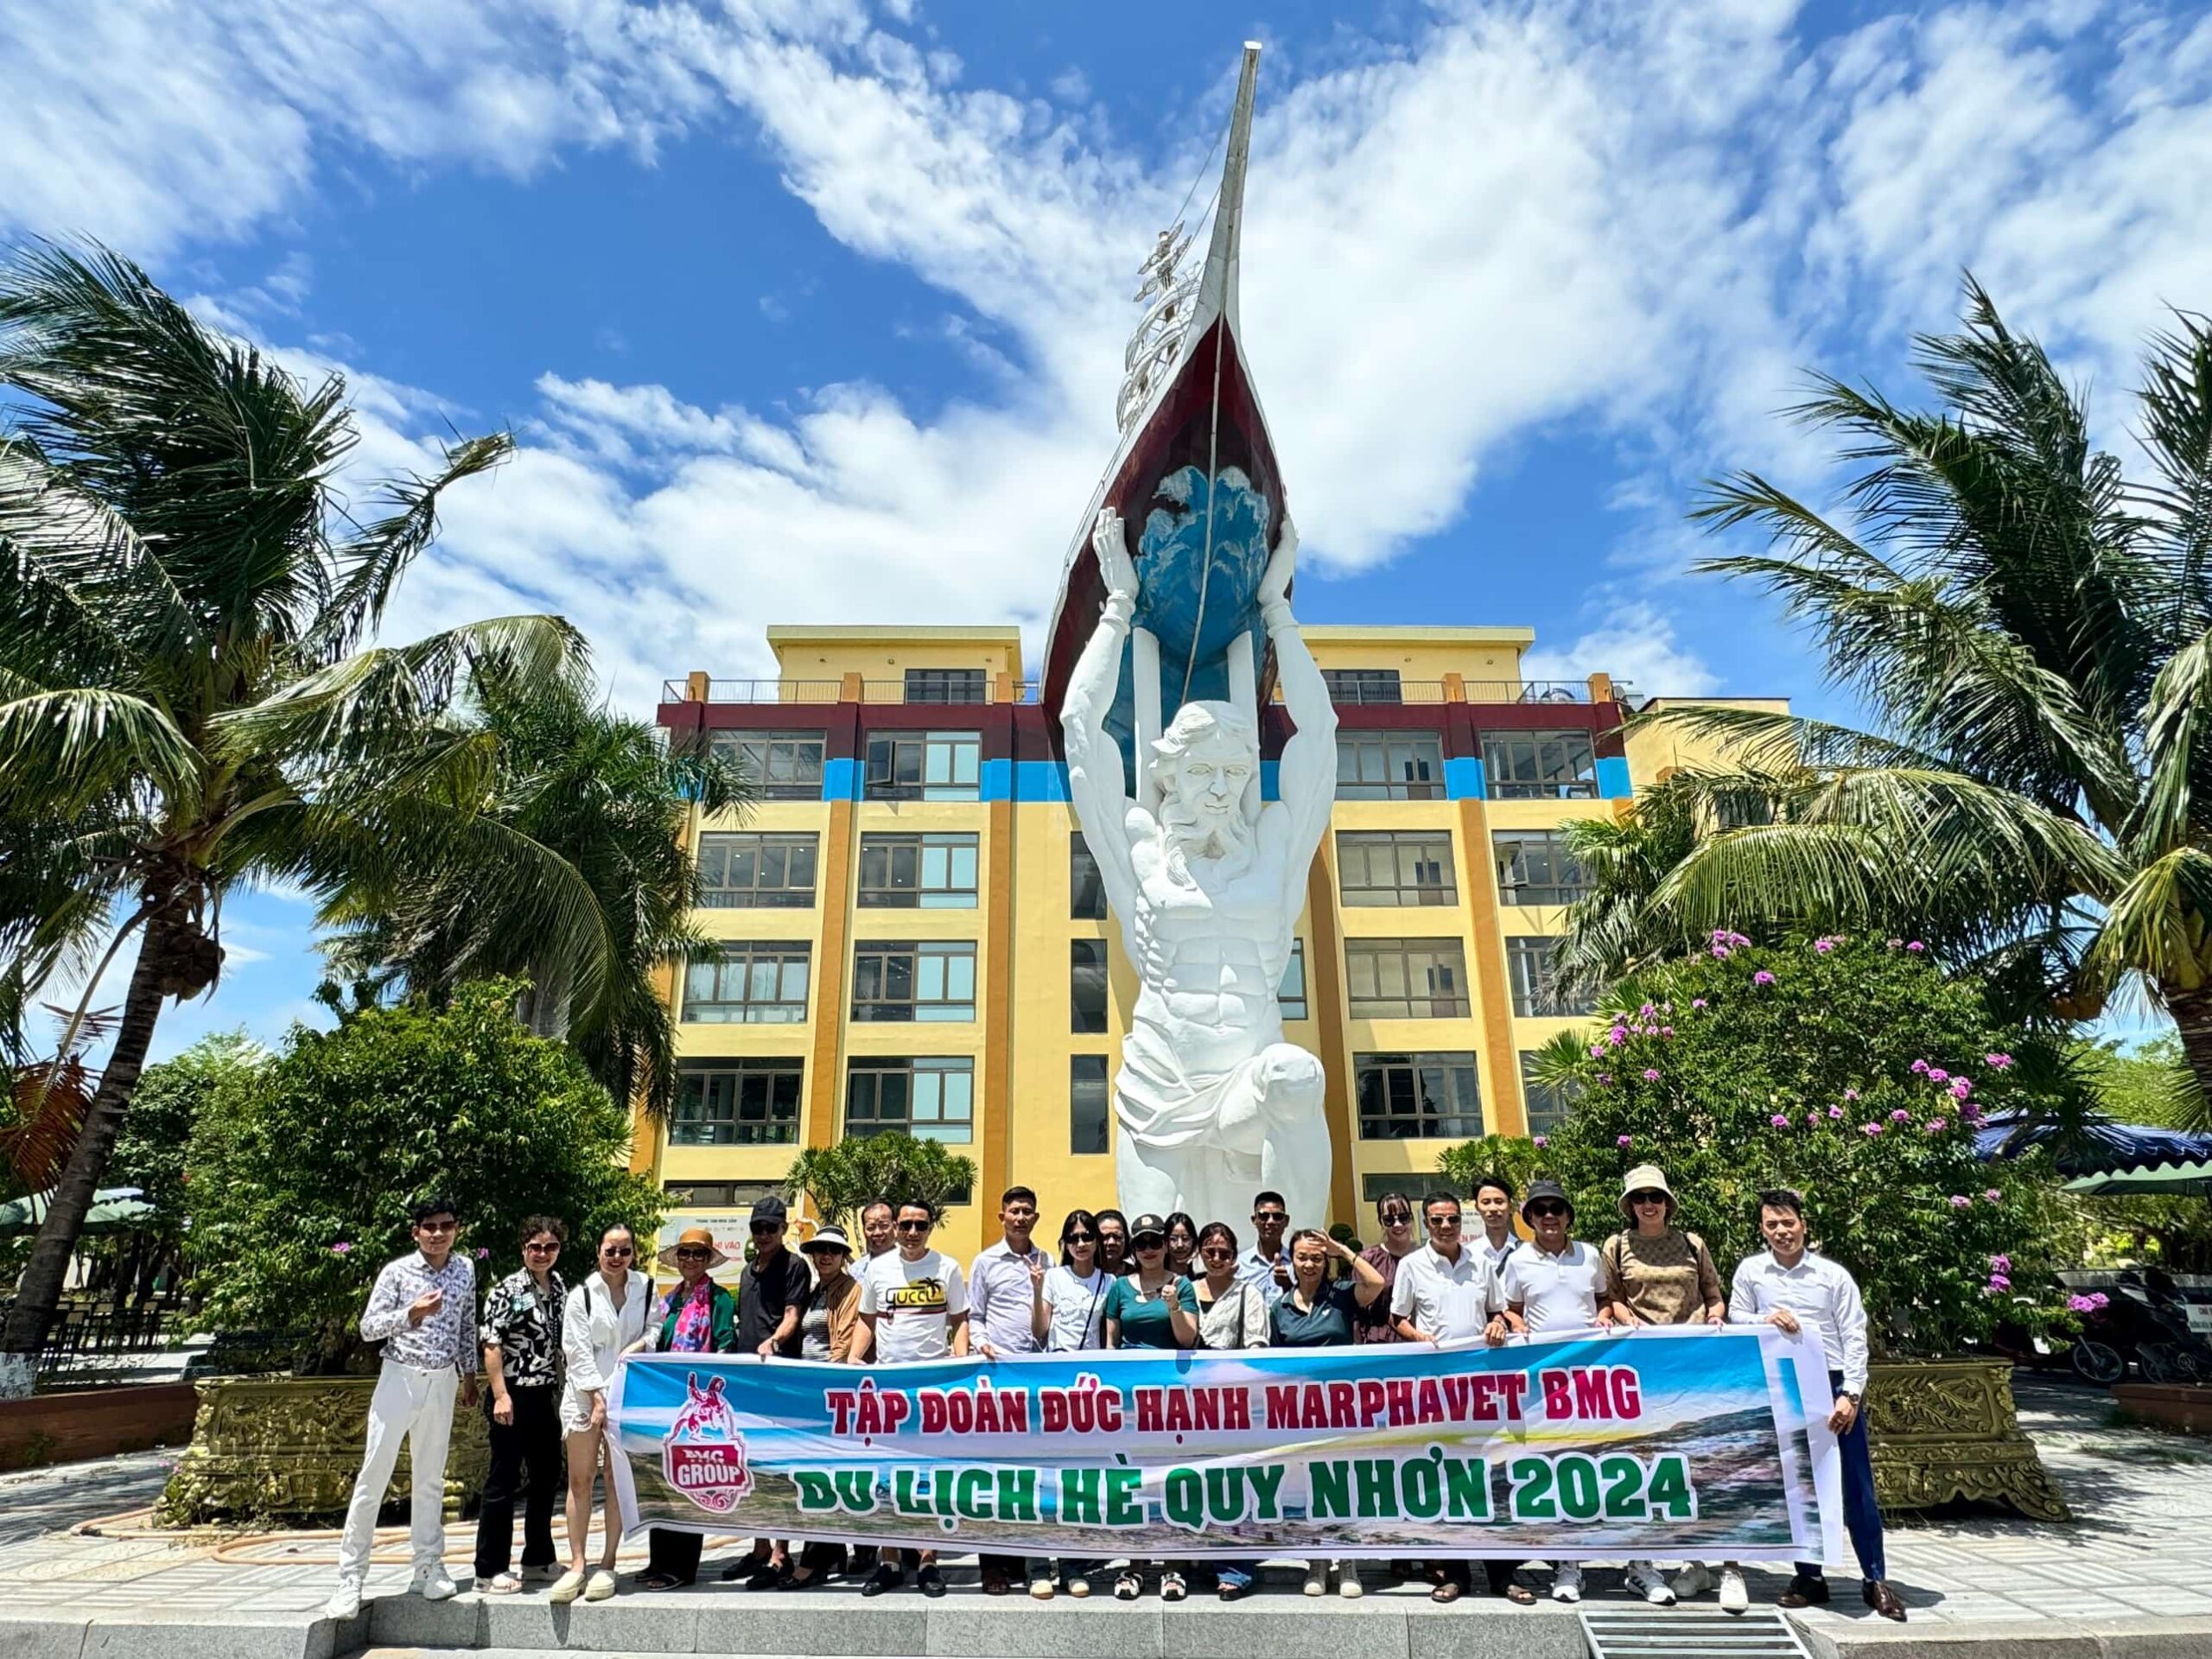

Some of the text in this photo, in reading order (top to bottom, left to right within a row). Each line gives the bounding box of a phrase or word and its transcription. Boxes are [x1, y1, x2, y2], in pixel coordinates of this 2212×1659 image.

[828, 1369, 1642, 1446] TẬP ĐOÀN ĐỨC HẠNH MARPHAVET BMG
[677, 1450, 741, 1486] BMG GROUP
[792, 1446, 1692, 1529] DU LỊCH HÈ QUY NHƠN 2024
